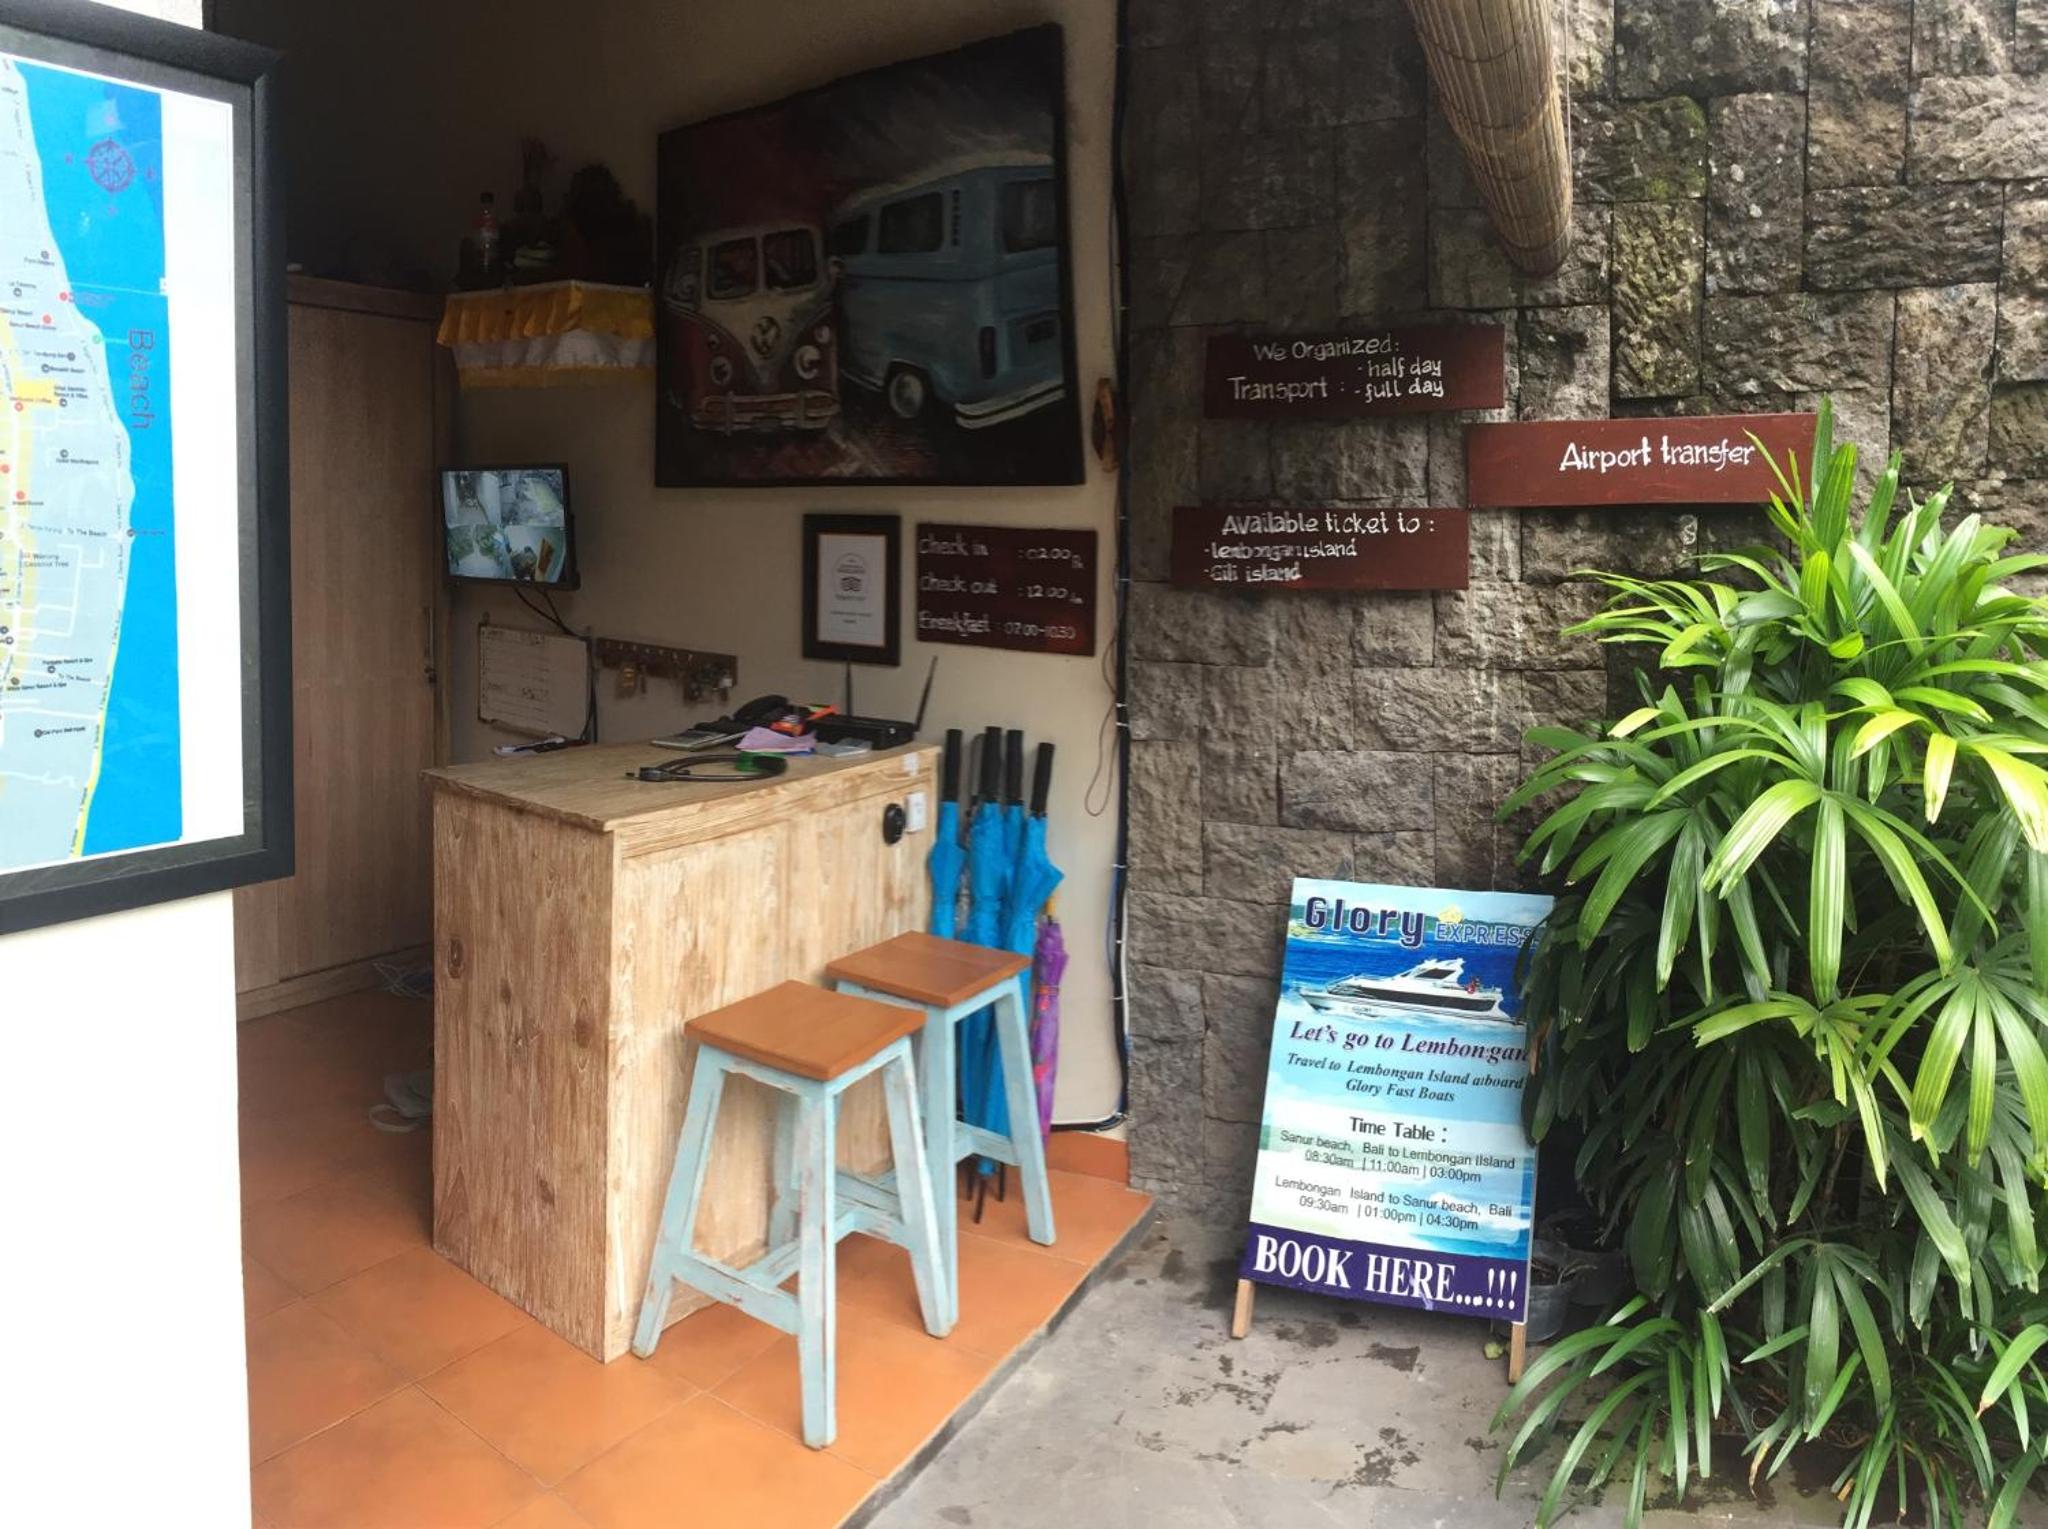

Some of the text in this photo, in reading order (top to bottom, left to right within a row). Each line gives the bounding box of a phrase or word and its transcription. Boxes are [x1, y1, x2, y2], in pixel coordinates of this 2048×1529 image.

[1253, 343, 1288, 361] We
[1409, 356, 1442, 377] day
[128, 329, 155, 429] Beach
[1227, 376, 1328, 403] Transport
[1408, 377, 1444, 398] day
[1559, 435, 1756, 474] Airport transfer
[1222, 511, 1320, 535] Available
[1326, 511, 1390, 534] ticket
[1397, 512, 1421, 533] to
[1246, 562, 1303, 582] island
[1304, 896, 1425, 949] Glory
[1342, 1032, 1369, 1050] go
[1374, 1034, 1394, 1049] to
[1288, 1052, 1328, 1069] Travel
[1328, 1060, 1341, 1071] to
[1347, 1060, 1424, 1081] Lembongan
[1428, 1069, 1470, 1085] Island
[1346, 1078, 1455, 1102] Glory Fast Boats
[1349, 1116, 1386, 1135] Time
[1394, 1122, 1435, 1141] Table
[1280, 1130, 1314, 1145] Sanur
[1362, 1142, 1384, 1155] Bali
[1388, 1145, 1400, 1157] to
[1402, 1147, 1472, 1167] Lembongan
[1305, 1149, 1354, 1168] 08:30am
[1370, 1159, 1419, 1175] 11:00am
[1429, 1166, 1482, 1183] 03:00pm
[1275, 1175, 1341, 1197] Lembongan
[1350, 1186, 1385, 1203] Island
[1388, 1193, 1400, 1205] to
[1403, 1194, 1439, 1209] Sanur
[1489, 1203, 1513, 1217] Bali
[1299, 1195, 1349, 1215] 09:30am
[1364, 1205, 1416, 1223] 01:00pm
[1426, 1213, 1479, 1231] 04:30pm
[1253, 1234, 1353, 1288] BOOK
